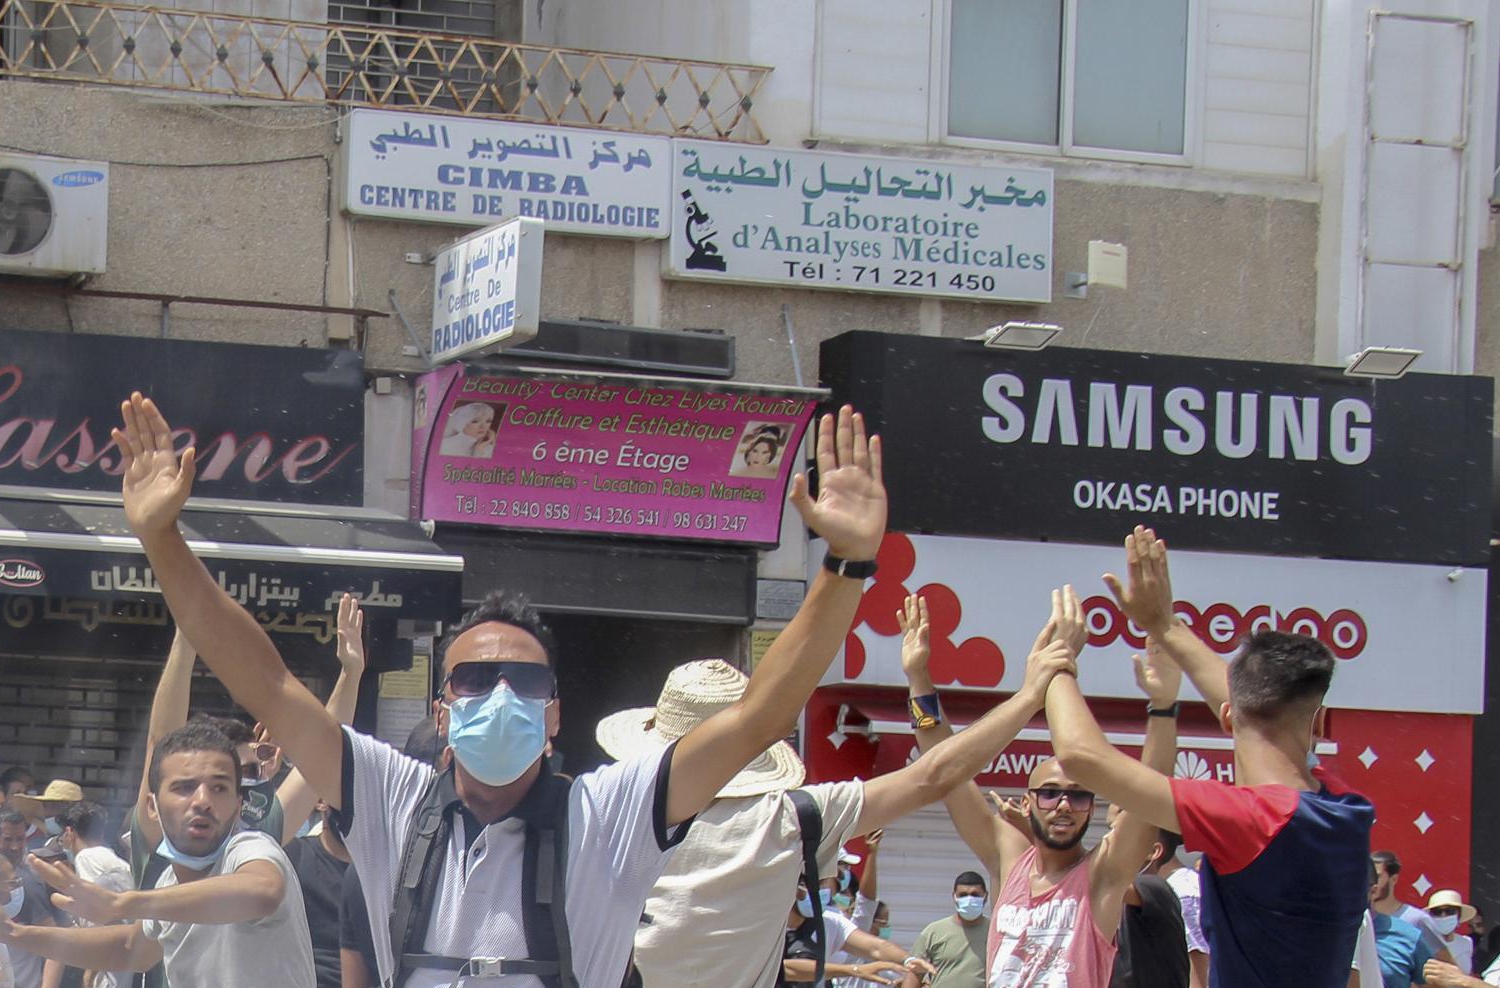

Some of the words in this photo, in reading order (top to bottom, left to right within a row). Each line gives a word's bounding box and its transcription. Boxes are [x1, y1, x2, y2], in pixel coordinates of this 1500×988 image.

[369, 121, 450, 160] الطبي
[467, 133, 573, 162] التصوير
[588, 138, 652, 173] مركز
[437, 163, 590, 197] CIMBA
[681, 147, 792, 194] الطبية
[801, 160, 954, 204] التحاليل
[360, 183, 457, 213] CENTRE
[472, 193, 503, 217] DE
[519, 197, 660, 229] RADIOLOGIE
[958, 175, 1048, 213] مخبر
[801, 201, 981, 239] Laboratoire
[495, 230, 516, 274] مركز
[891, 235, 1046, 271] Médicales
[784, 259, 825, 281] Tél
[852, 265, 882, 284] 71
[893, 269, 938, 288] 221
[949, 272, 997, 293] 450
[448, 288, 480, 314] Centre
[487, 278, 501, 298] De
[434, 299, 515, 354] RADIOLOGIE
[462, 377, 540, 399] Beauty
[551, 381, 620, 402] Center
[624, 387, 674, 408] Chez
[678, 392, 728, 413] Elyes
[509, 404, 593, 430] Coiffure
[598, 415, 620, 433] et
[625, 413, 736, 442] Esthétique
[981, 373, 1373, 466] SAMSUNG
[532, 441, 547, 461] 6
[554, 439, 609, 466] ème
[616, 439, 690, 474] Étage
[443, 463, 516, 486] Spécialité
[519, 469, 578, 490] Mariées
[593, 474, 657, 494] Location
[661, 478, 706, 498] Robes
[709, 482, 767, 503] Mariées
[1073, 480, 1172, 514] OKASA
[1178, 486, 1280, 521] PHONE
[455, 495, 477, 514] Tél
[490, 499, 508, 516] 22
[511, 502, 541, 518] 840
[544, 503, 571, 520] 858
[584, 506, 601, 523] 54
[605, 507, 632, 525] 326
[636, 509, 660, 526] 541
[673, 511, 691, 529] 98
[694, 513, 718, 530] 631
[721, 515, 749, 533] 247
[979, 753, 1051, 775] UAW
